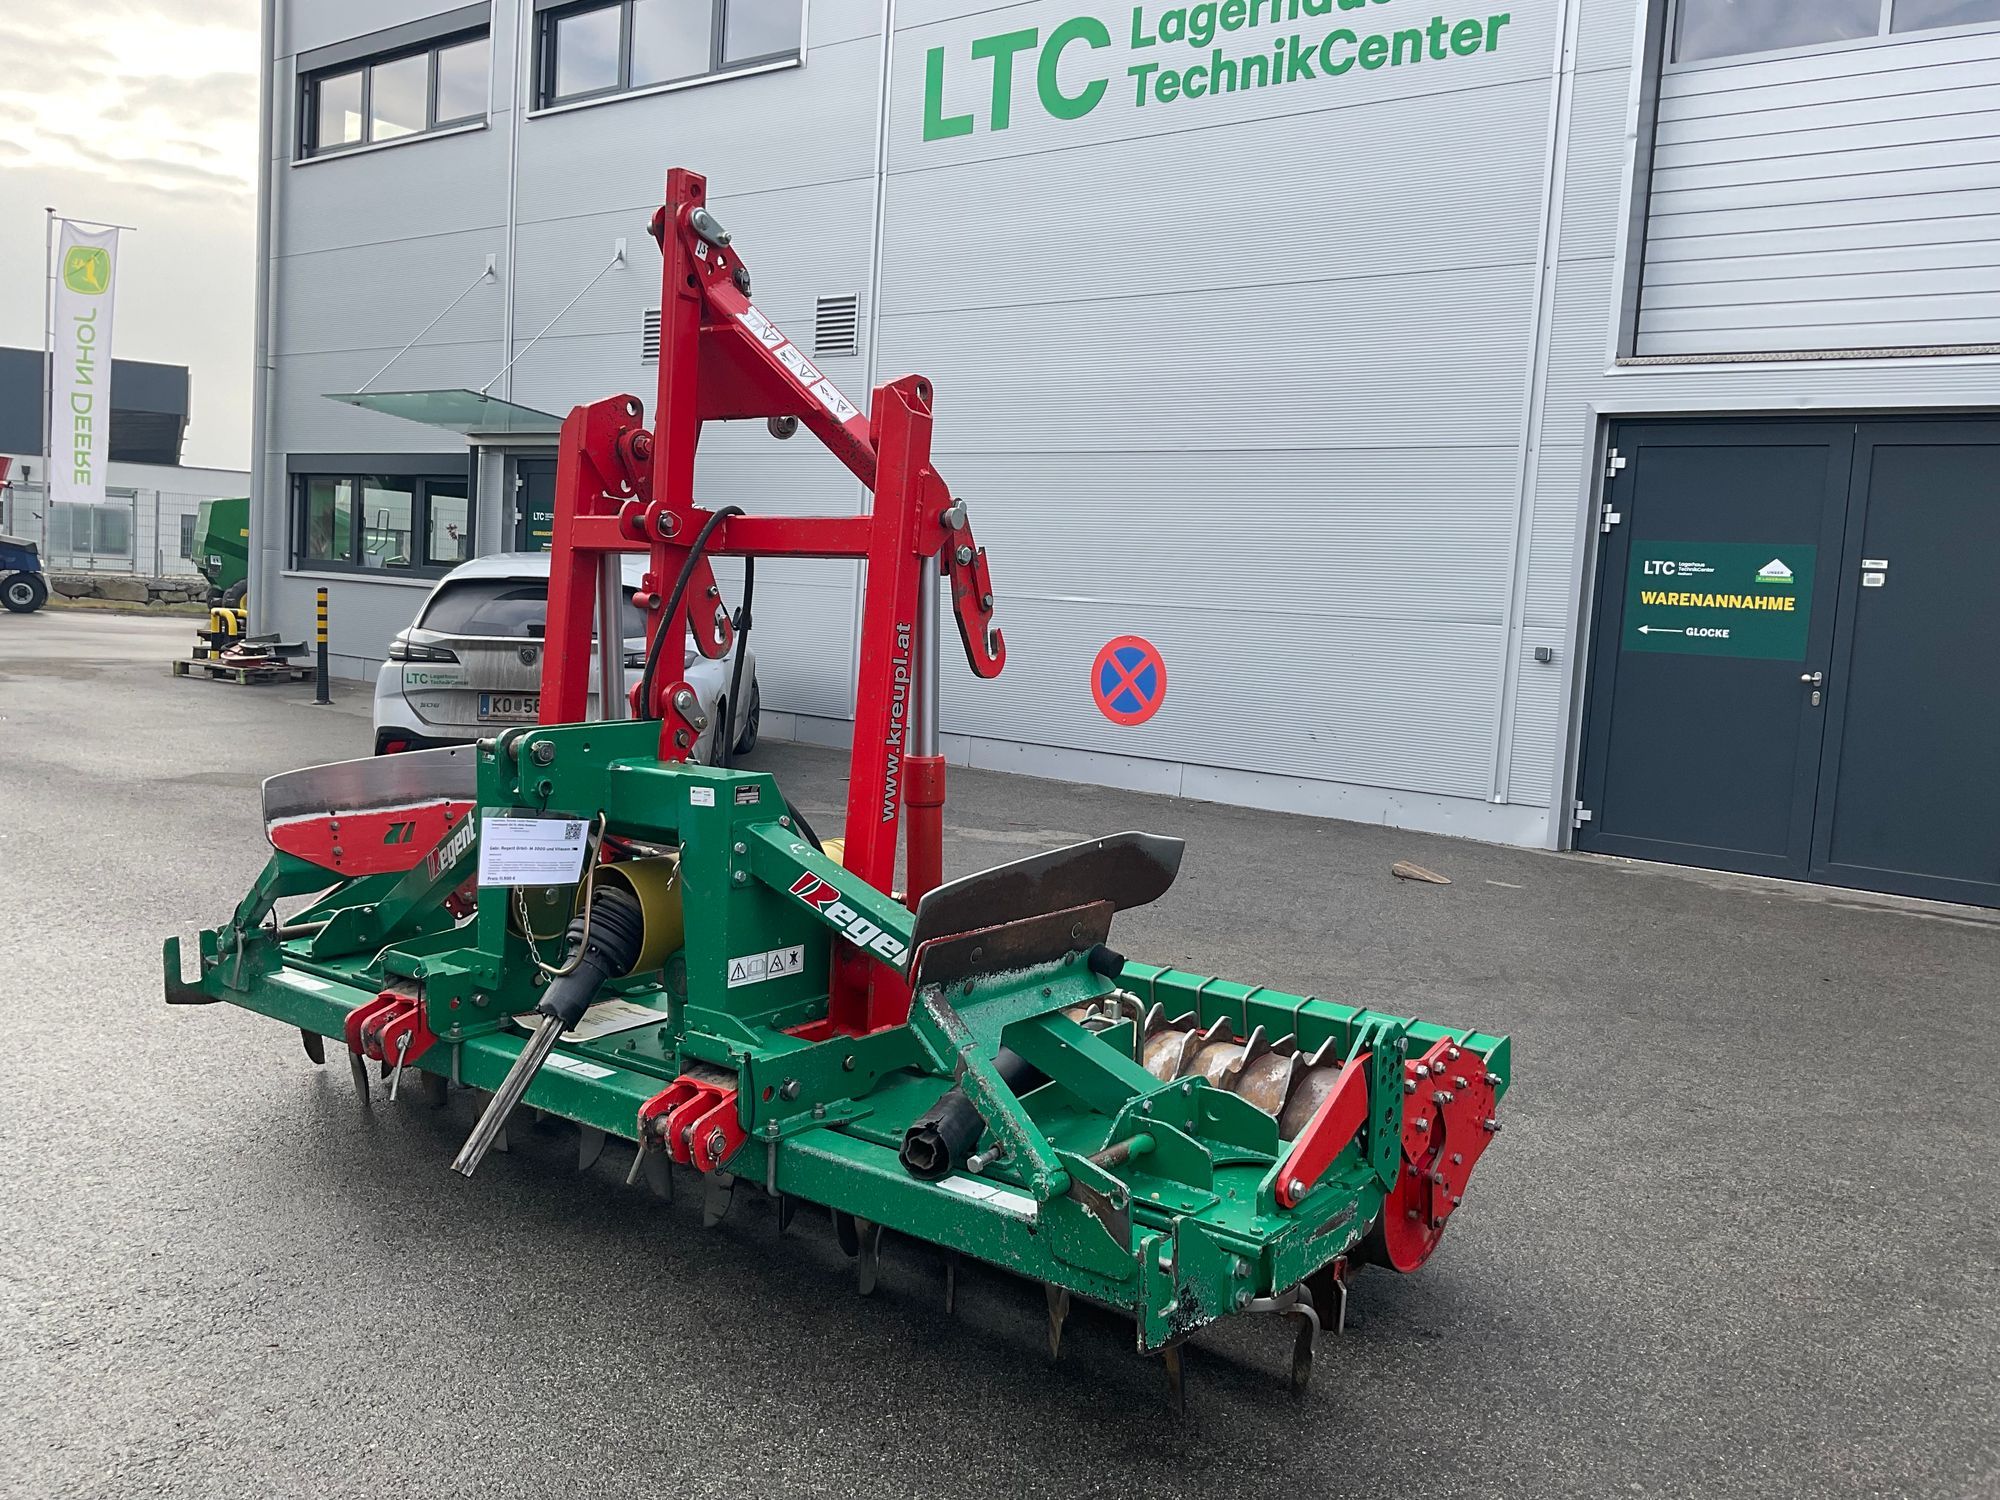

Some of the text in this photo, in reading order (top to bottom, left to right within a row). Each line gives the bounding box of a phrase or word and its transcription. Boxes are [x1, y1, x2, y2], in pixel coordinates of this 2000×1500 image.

[1127, 12, 1511, 108] TechnikCenter
[922, 15, 1111, 142] LTC
[533, 511, 545, 521] LTC
[1643, 560, 1676, 576] LTC
[1641, 591, 1796, 611] WARENANNAHME
[1685, 626, 1730, 639] GLOCKE
[406, 672, 428, 685] LTC
[492, 697, 512, 713] KO
[881, 622, 912, 823] www.kreupl.at
[426, 810, 477, 882] Regent
